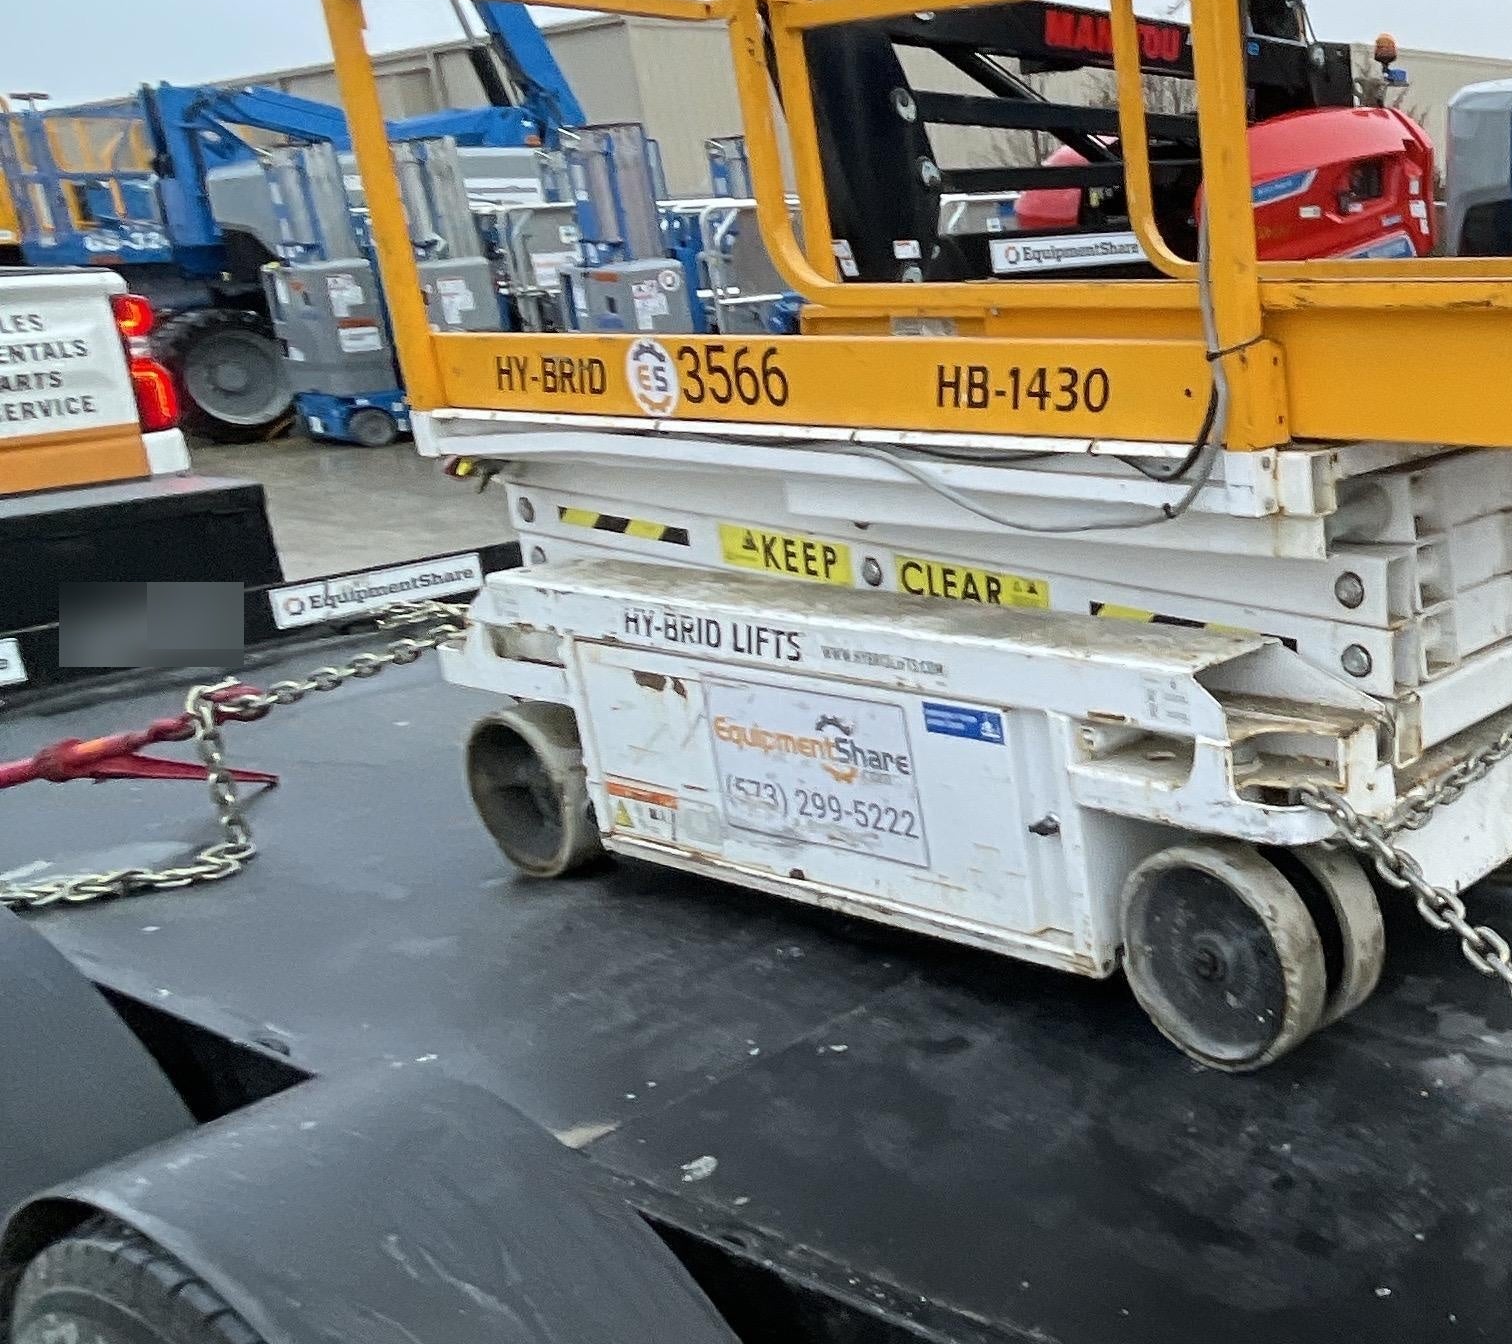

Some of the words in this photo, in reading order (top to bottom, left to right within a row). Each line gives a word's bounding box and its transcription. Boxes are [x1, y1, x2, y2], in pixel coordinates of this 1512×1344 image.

[496, 355, 607, 395] HY-BRID
[677, 345, 788, 407] 3566
[936, 364, 1110, 414] HB-1430
[309, 567, 474, 607] EquipmentShare
[761, 534, 836, 578] KEEP
[901, 561, 1002, 605] CLEAR
[624, 608, 721, 647] HY-BRID
[732, 623, 802, 661] LIFTS
[713, 716, 910, 775] EquipmentShare
[726, 774, 788, 818] (573)
[795, 789, 919, 839] 299-5222
